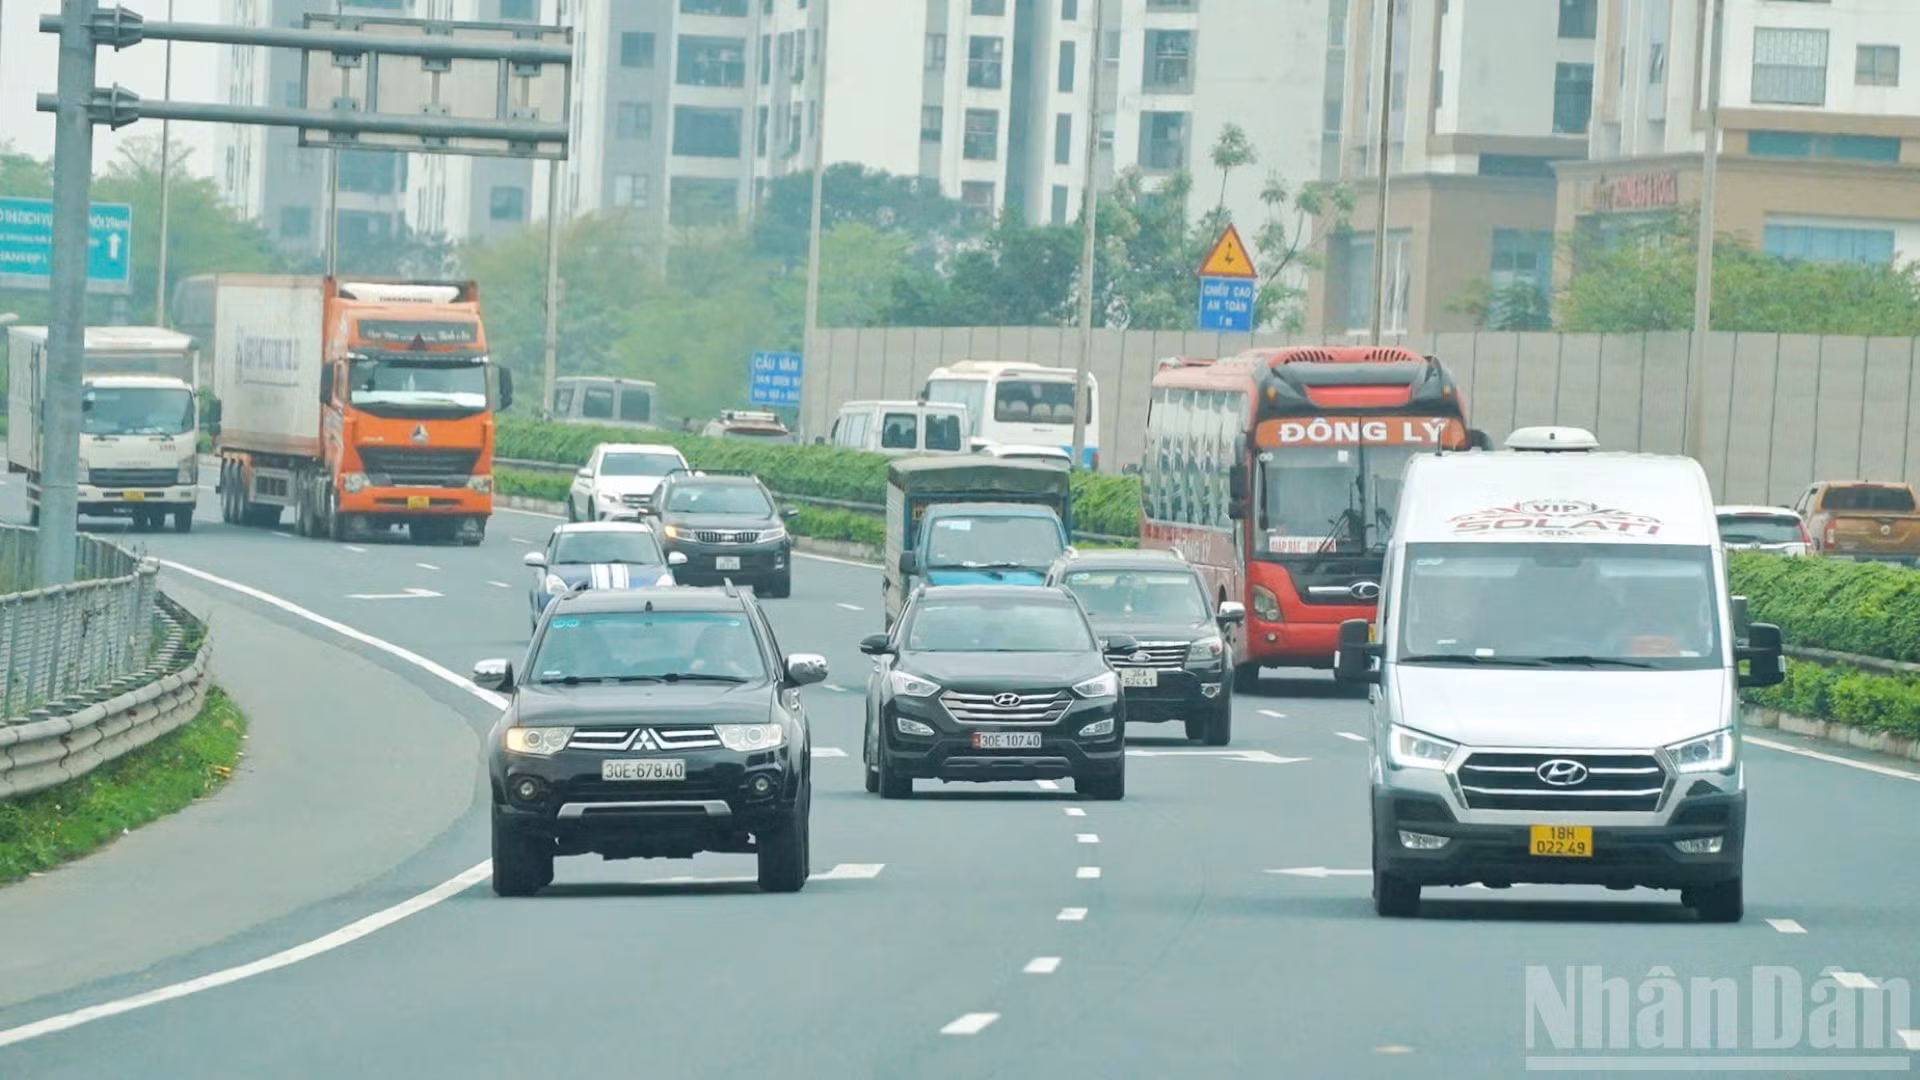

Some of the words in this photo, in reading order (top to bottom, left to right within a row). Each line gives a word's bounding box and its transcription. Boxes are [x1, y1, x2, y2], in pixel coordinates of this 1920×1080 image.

[1233, 286, 1251, 298] CAO
[1207, 300, 1220, 311] AN
[1278, 417, 1388, 442] ĐÔNG
[1403, 417, 1446, 443] LÝ
[1533, 504, 1579, 513] VIP
[1452, 518, 1661, 536] SOLATI
[606, 763, 683, 779] 30E-678.40
[1551, 827, 1575, 840] 18H
